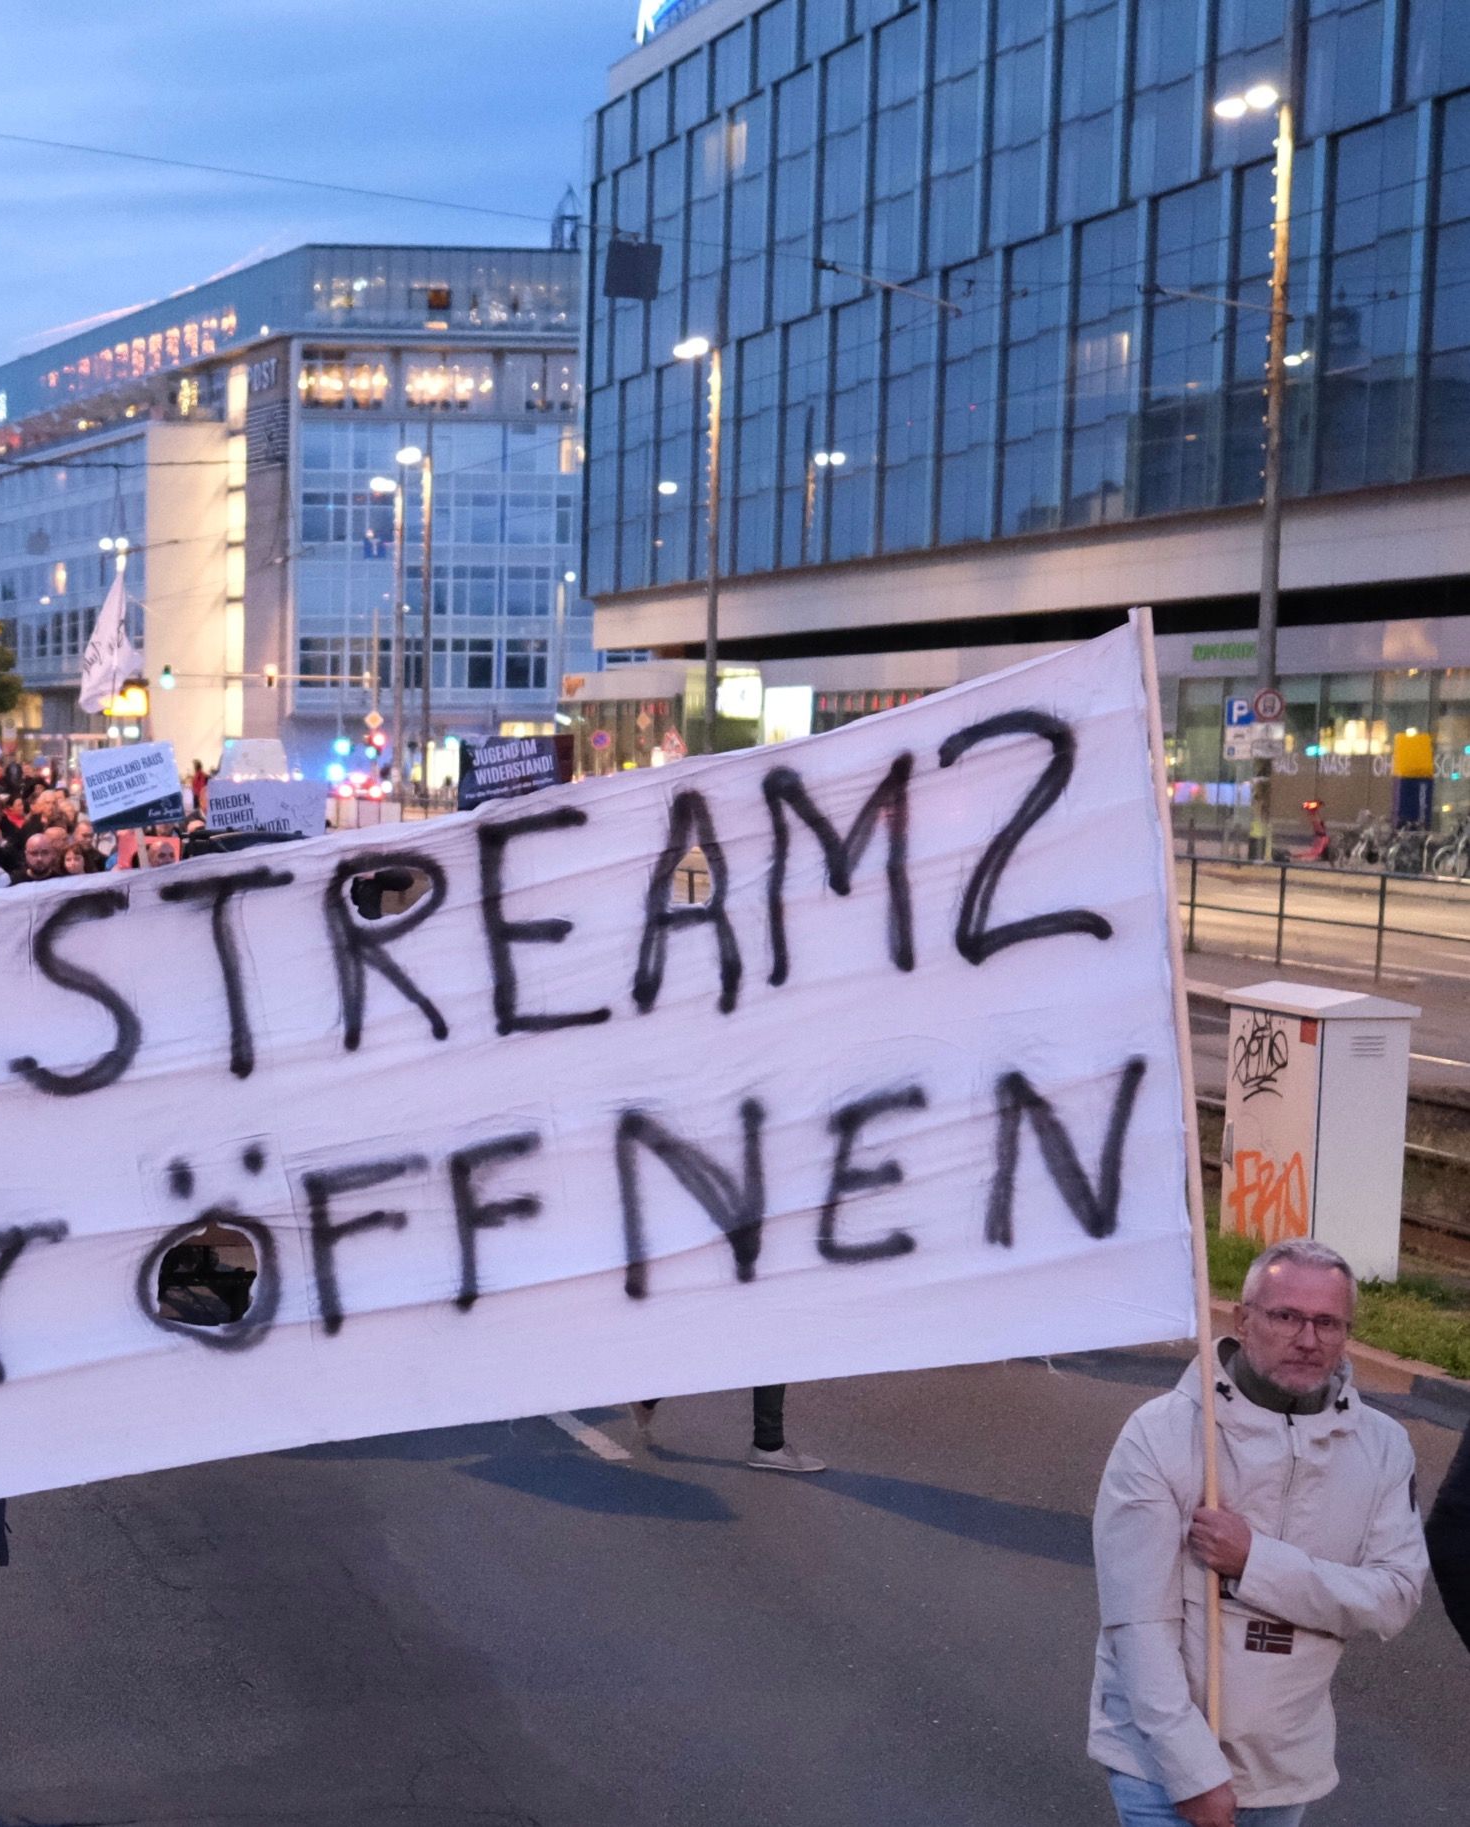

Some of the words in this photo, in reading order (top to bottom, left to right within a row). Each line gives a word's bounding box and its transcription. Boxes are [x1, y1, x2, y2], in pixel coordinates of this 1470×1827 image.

[473, 741, 520, 766] JUGEND
[520, 738, 537, 757] IM
[86, 760, 141, 788] DEUTSCHLAND
[140, 752, 164, 769] RAUS
[474, 754, 554, 786] WIDERSTAND!
[1319, 754, 1351, 776] NASE
[91, 785, 109, 801] AUS
[108, 780, 125, 797] DER
[210, 793, 255, 811] FRIEDEN,
[212, 808, 258, 827] FREIHEIT,
[136, 1054, 1147, 1353] ÖFFNEN
